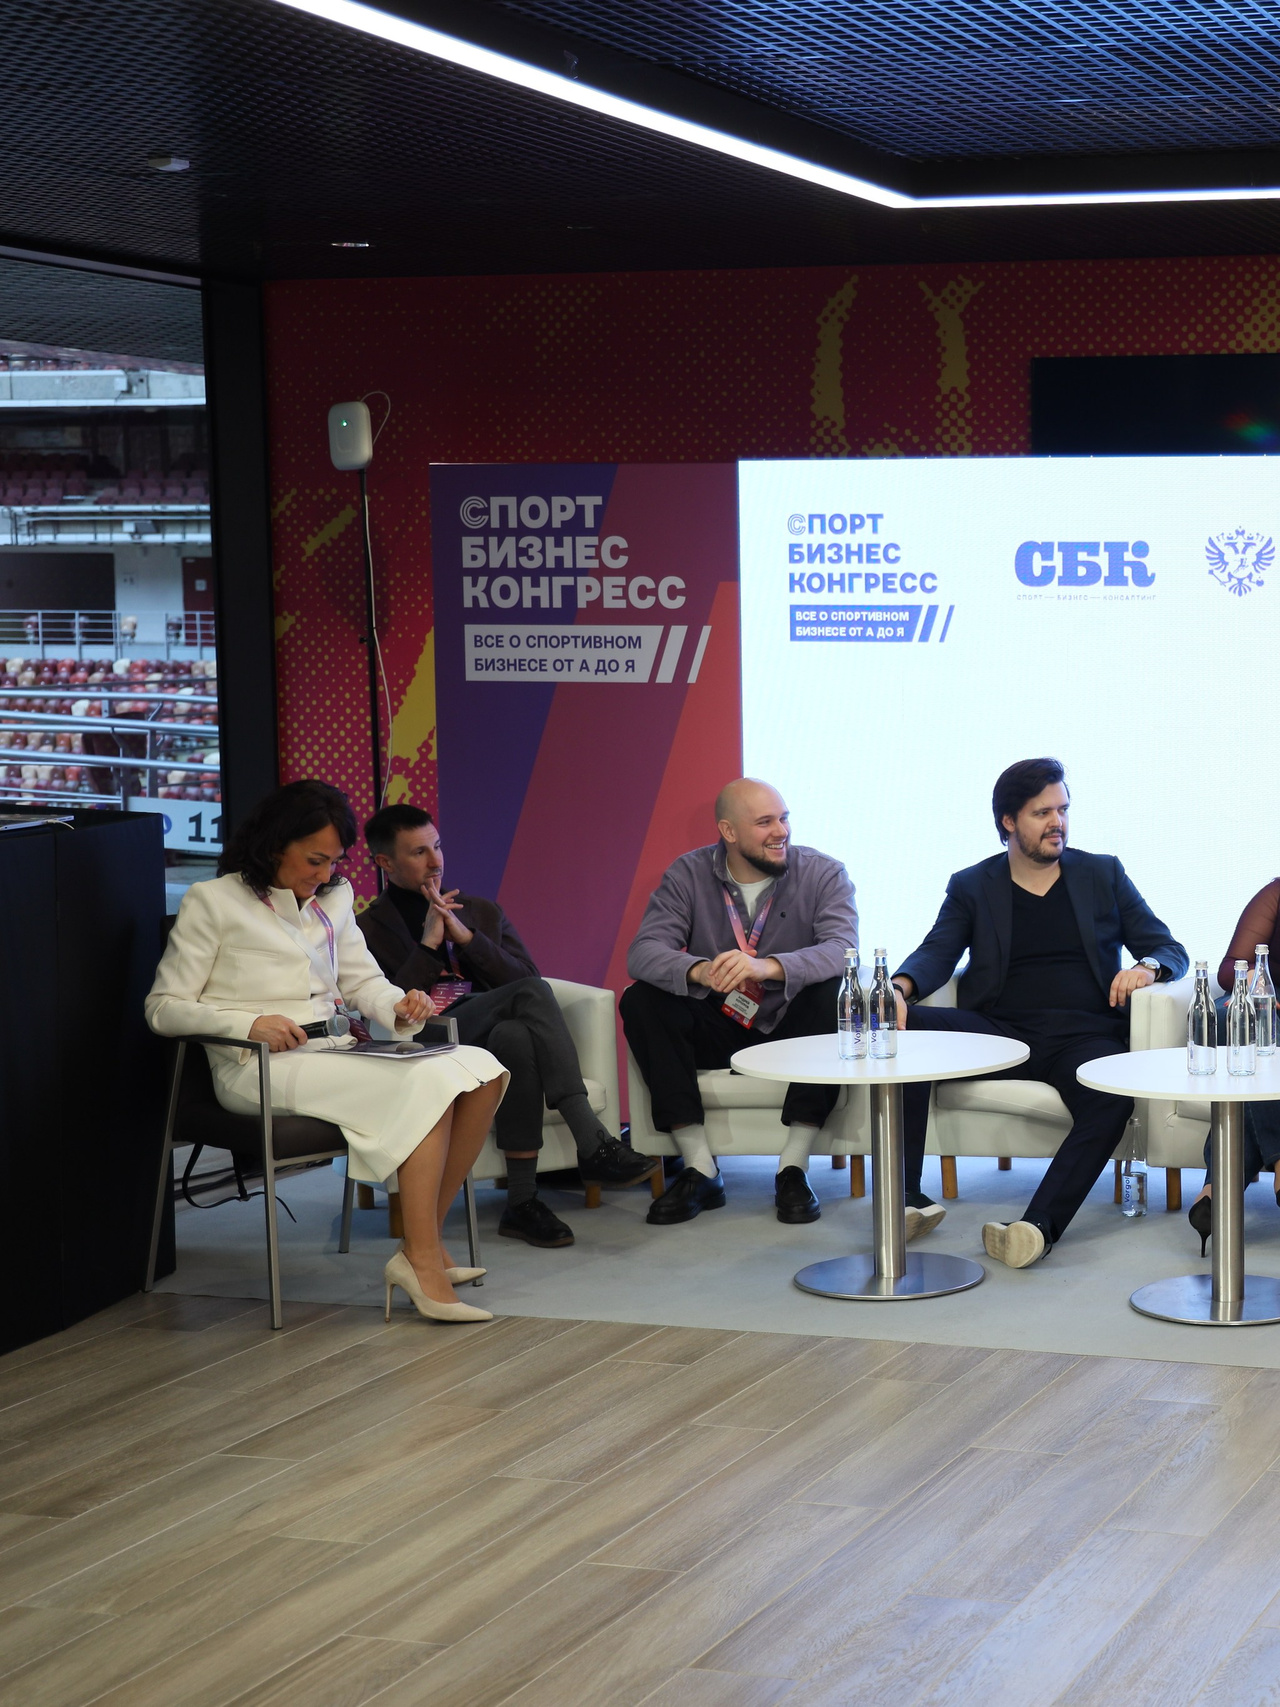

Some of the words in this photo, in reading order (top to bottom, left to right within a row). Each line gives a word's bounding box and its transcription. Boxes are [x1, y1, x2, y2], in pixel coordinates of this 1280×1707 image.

[460, 496, 603, 529] СПОРТ
[787, 513, 884, 536] СПОРТ
[461, 535, 629, 569] БИЗНЕС
[788, 543, 901, 565] БИЗНЕС
[1014, 540, 1156, 587] СБК
[462, 576, 686, 609] КОНГРЕСС
[788, 572, 938, 594] КОНГРЕСС
[795, 611, 816, 621] ВСЕ
[819, 611, 828, 621] О
[831, 611, 910, 622] СПОРТИВНОМ
[473, 634, 506, 649] ВСЕ
[509, 635, 522, 649] О
[525, 635, 642, 650] СПОРТИВНОМ
[795, 627, 846, 637] БИЗНЕСЕ
[848, 627, 864, 637] ОТ
[865, 627, 875, 637] А
[876, 627, 893, 639] ДО
[896, 628, 905, 637] Я
[474, 658, 548, 673] БИЗНЕСЕ
[552, 658, 575, 673] ОТ
[578, 659, 591, 673] А
[594, 659, 620, 676] ДО
[624, 659, 636, 673] Я
